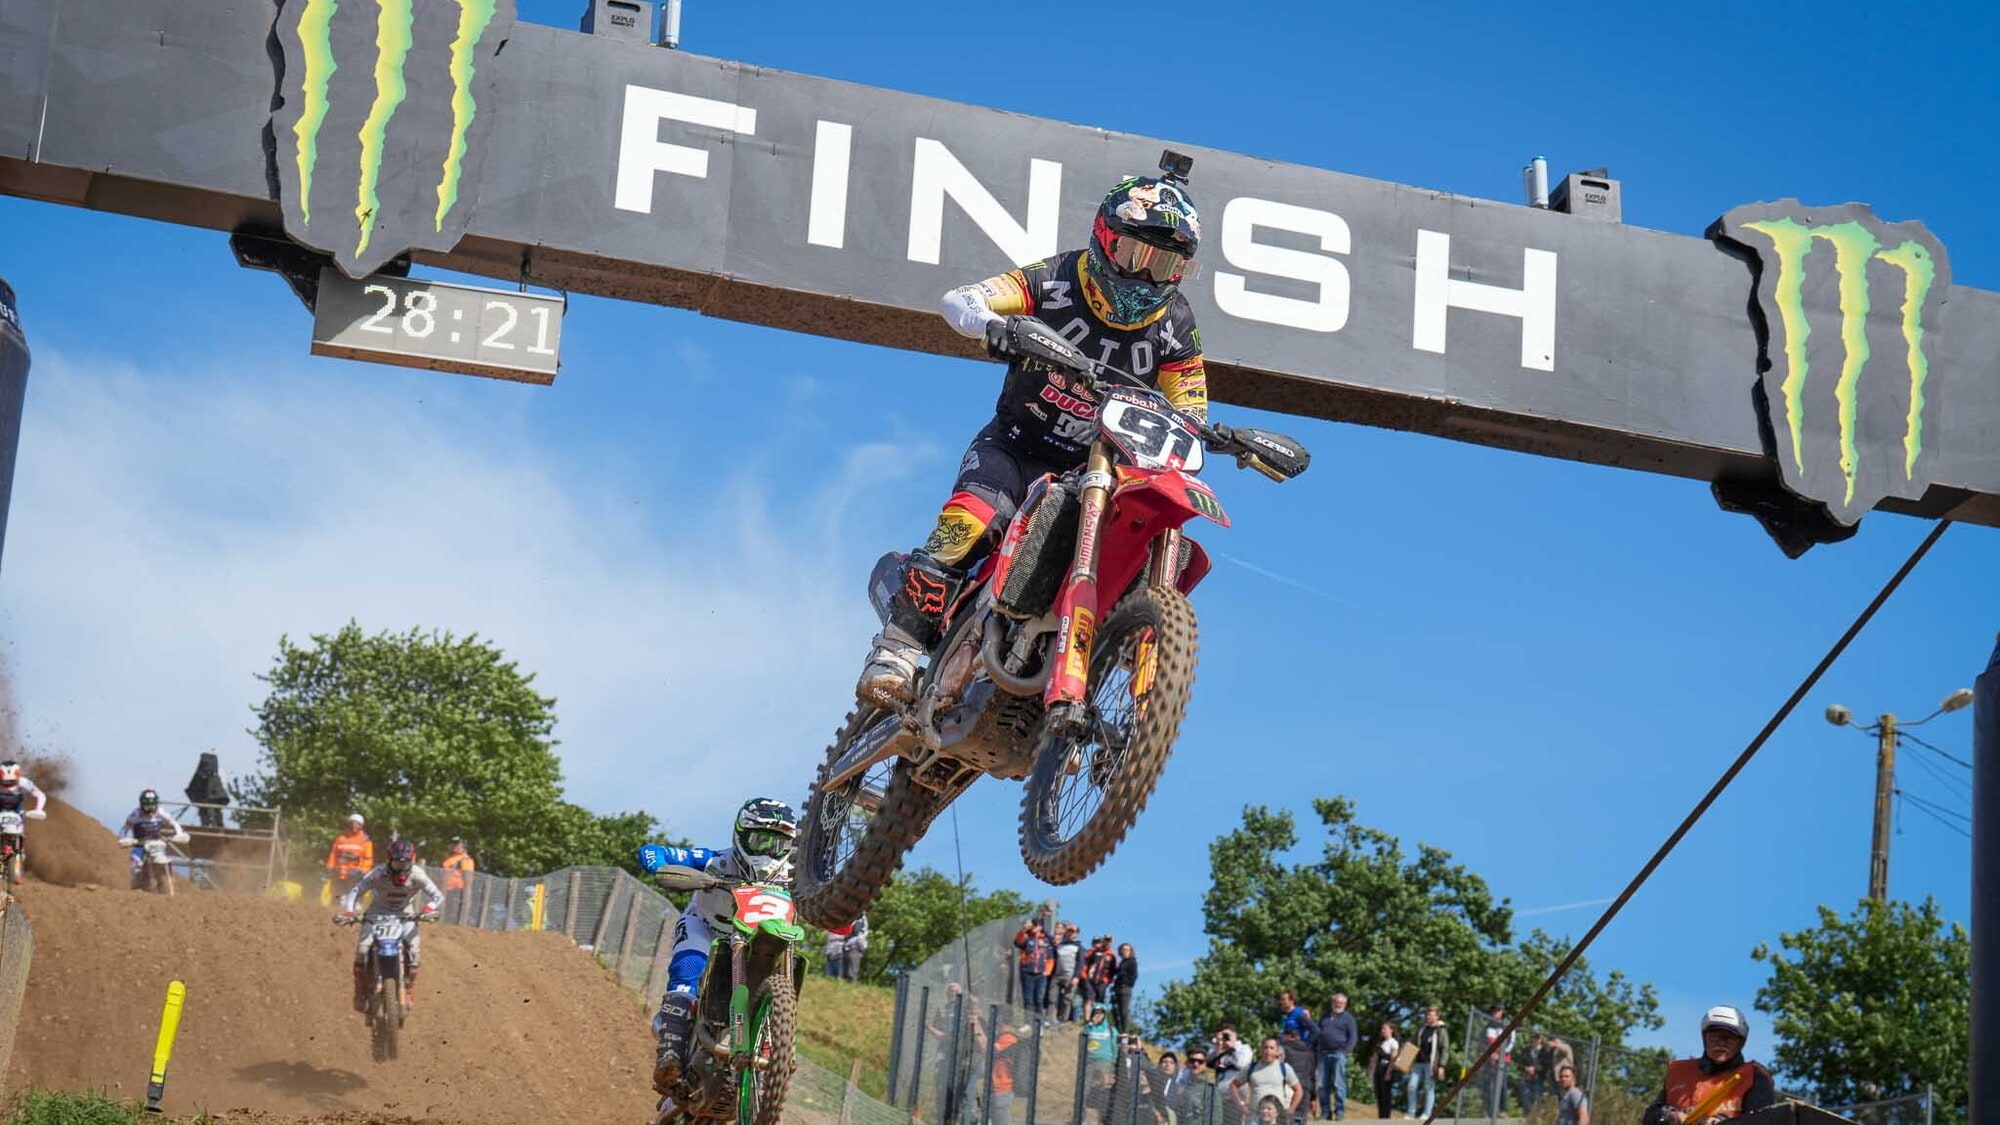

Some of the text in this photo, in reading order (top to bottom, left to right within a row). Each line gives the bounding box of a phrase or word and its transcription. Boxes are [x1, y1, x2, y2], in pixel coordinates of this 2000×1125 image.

[614, 84, 1558, 372] FINSH
[360, 284, 555, 355] 28:21
[1028, 332, 1073, 358] ACERBIS
[1113, 406, 1195, 469] 91
[1253, 436, 1295, 458] ACERBIS
[743, 894, 791, 923] 3
